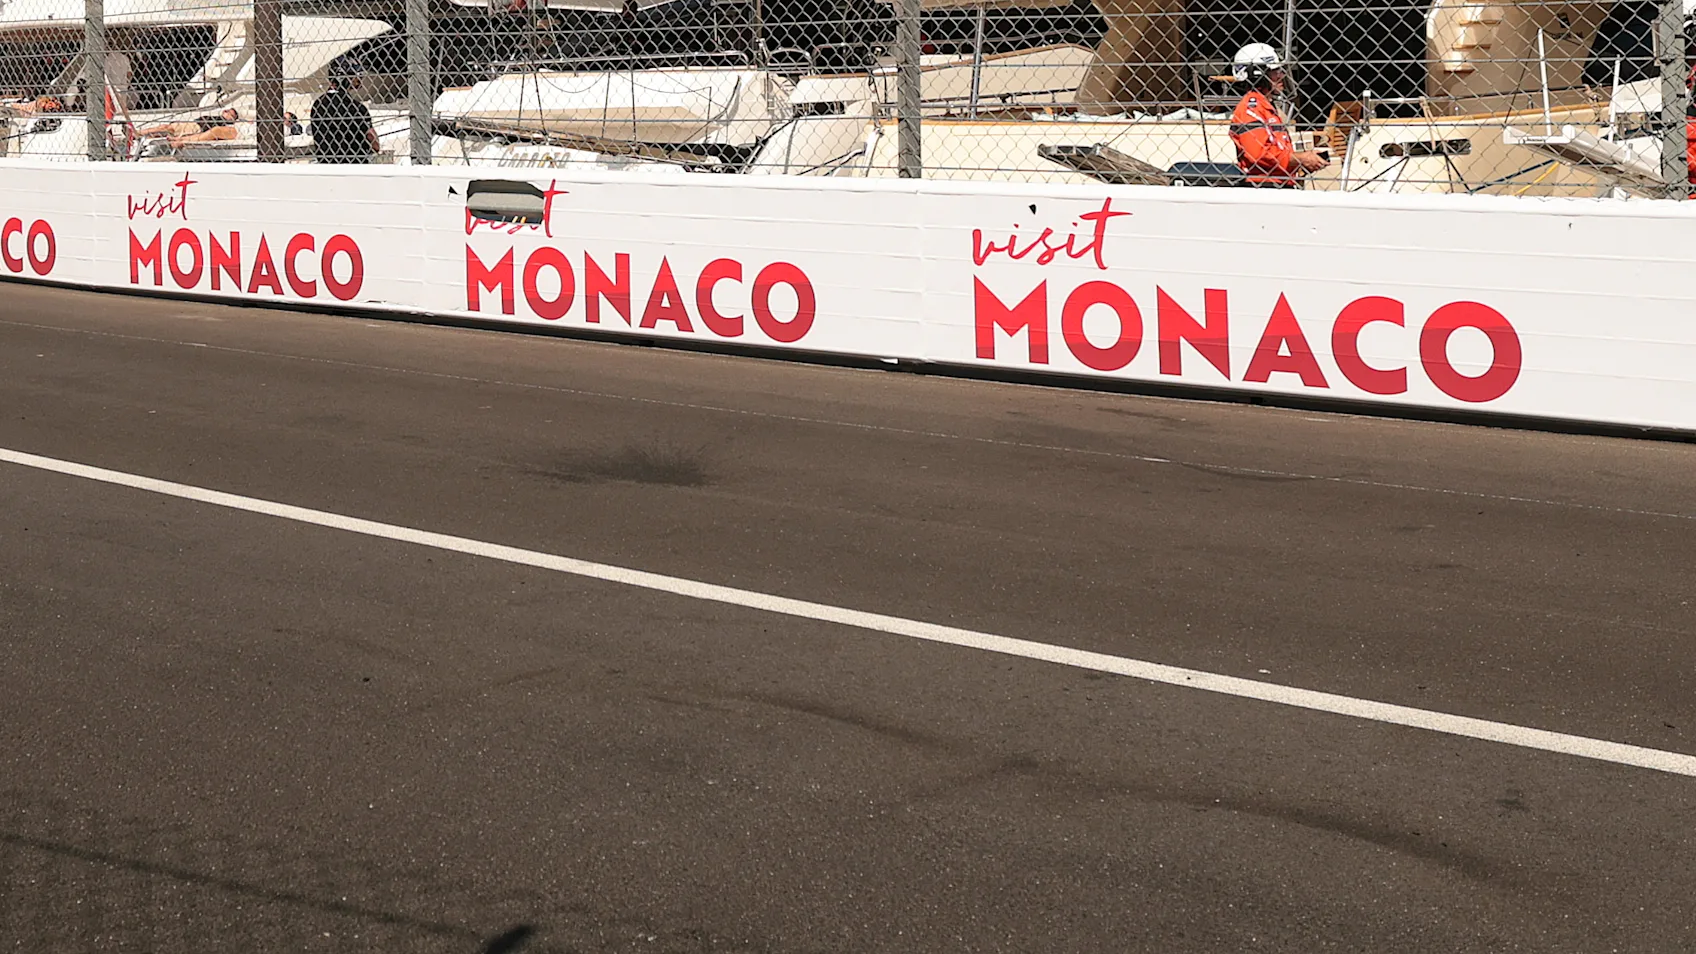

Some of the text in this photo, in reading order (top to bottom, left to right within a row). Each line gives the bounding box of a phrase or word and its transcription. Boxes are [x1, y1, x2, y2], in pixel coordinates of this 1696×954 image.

[126, 171, 197, 221] visit
[129, 228, 364, 301] MONACO
[971, 197, 1133, 271] visit
[466, 245, 816, 343] MONACO
[973, 275, 1523, 403] MONACO
